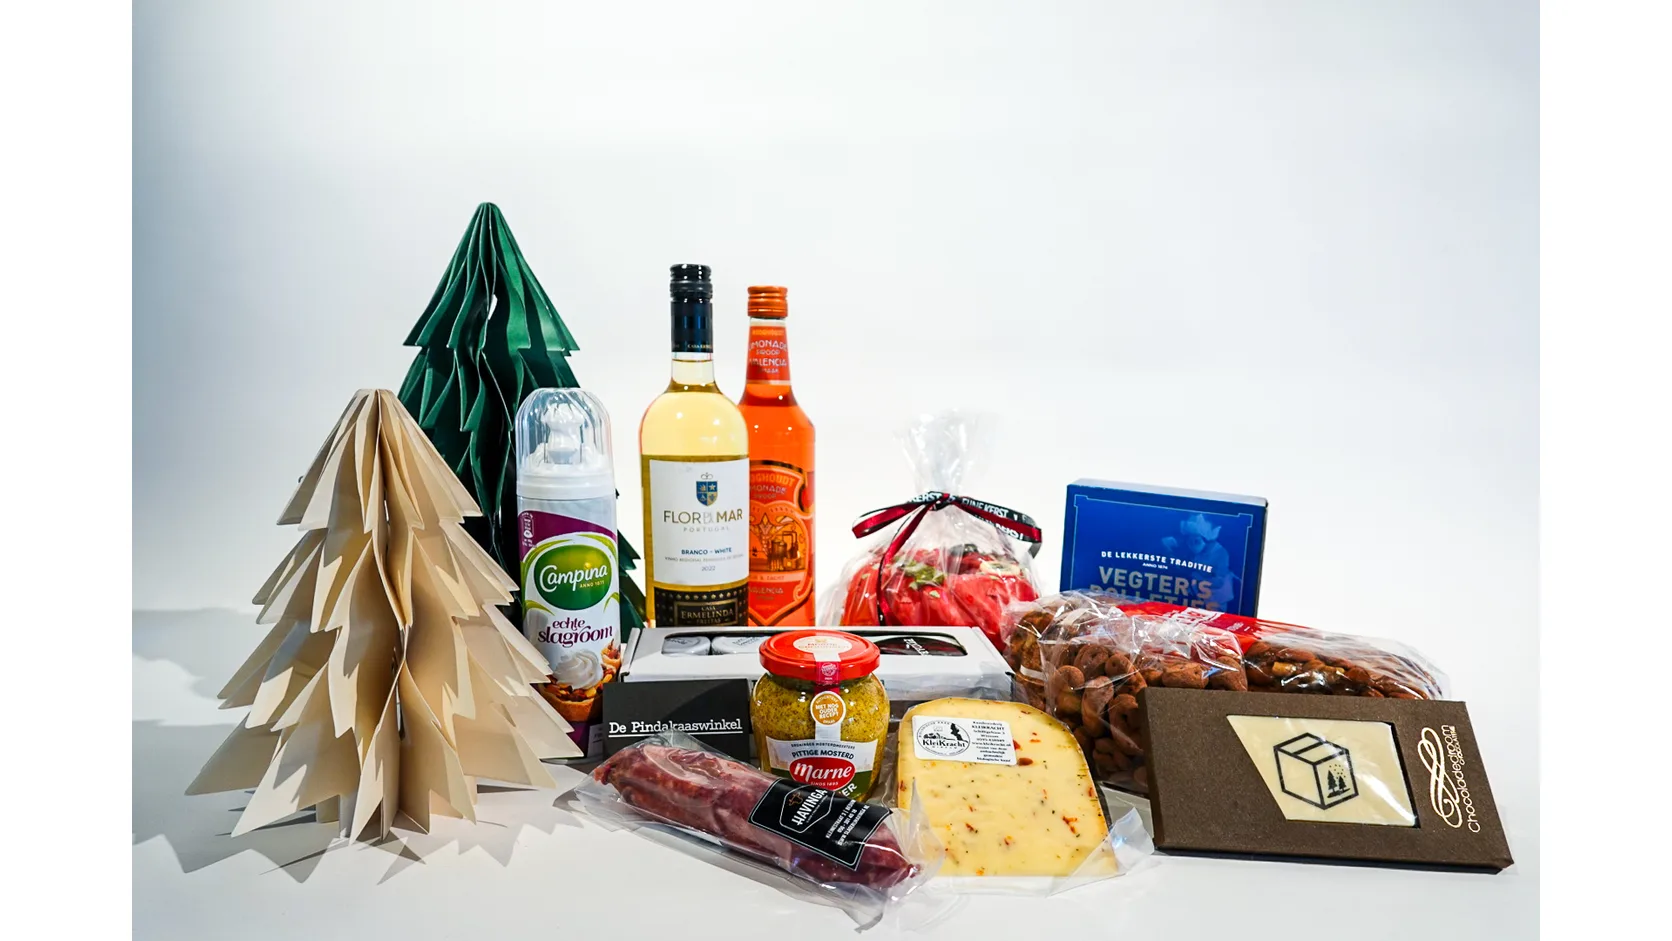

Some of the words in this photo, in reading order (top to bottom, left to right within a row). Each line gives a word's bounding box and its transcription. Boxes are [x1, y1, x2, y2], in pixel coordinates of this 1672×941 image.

[749, 471, 796, 487] OGHOUDT
[749, 484, 787, 495] MONADE
[663, 510, 702, 524] FLOR
[716, 508, 743, 523] MAR
[1115, 551, 1167, 564] LEKKERSTE
[1170, 557, 1213, 573] TRADITIE
[540, 564, 608, 593] Campina
[580, 580, 595, 588] ANNO
[1098, 565, 1213, 600] VEGTER'S
[681, 602, 734, 619] ERMELINDA
[552, 617, 586, 632] echte
[537, 625, 613, 648] slagroom
[608, 721, 627, 734] De
[631, 718, 743, 733] Pindakaaswinkel
[922, 738, 966, 748] KleiKracht
[791, 749, 819, 758] PITTIGE
[820, 749, 855, 760] MOSTERD
[794, 762, 853, 783] Marne
[1441, 724, 1481, 833] Chocoladedroom
[841, 783, 858, 797] ER
[791, 789, 828, 826] HAVINGA
